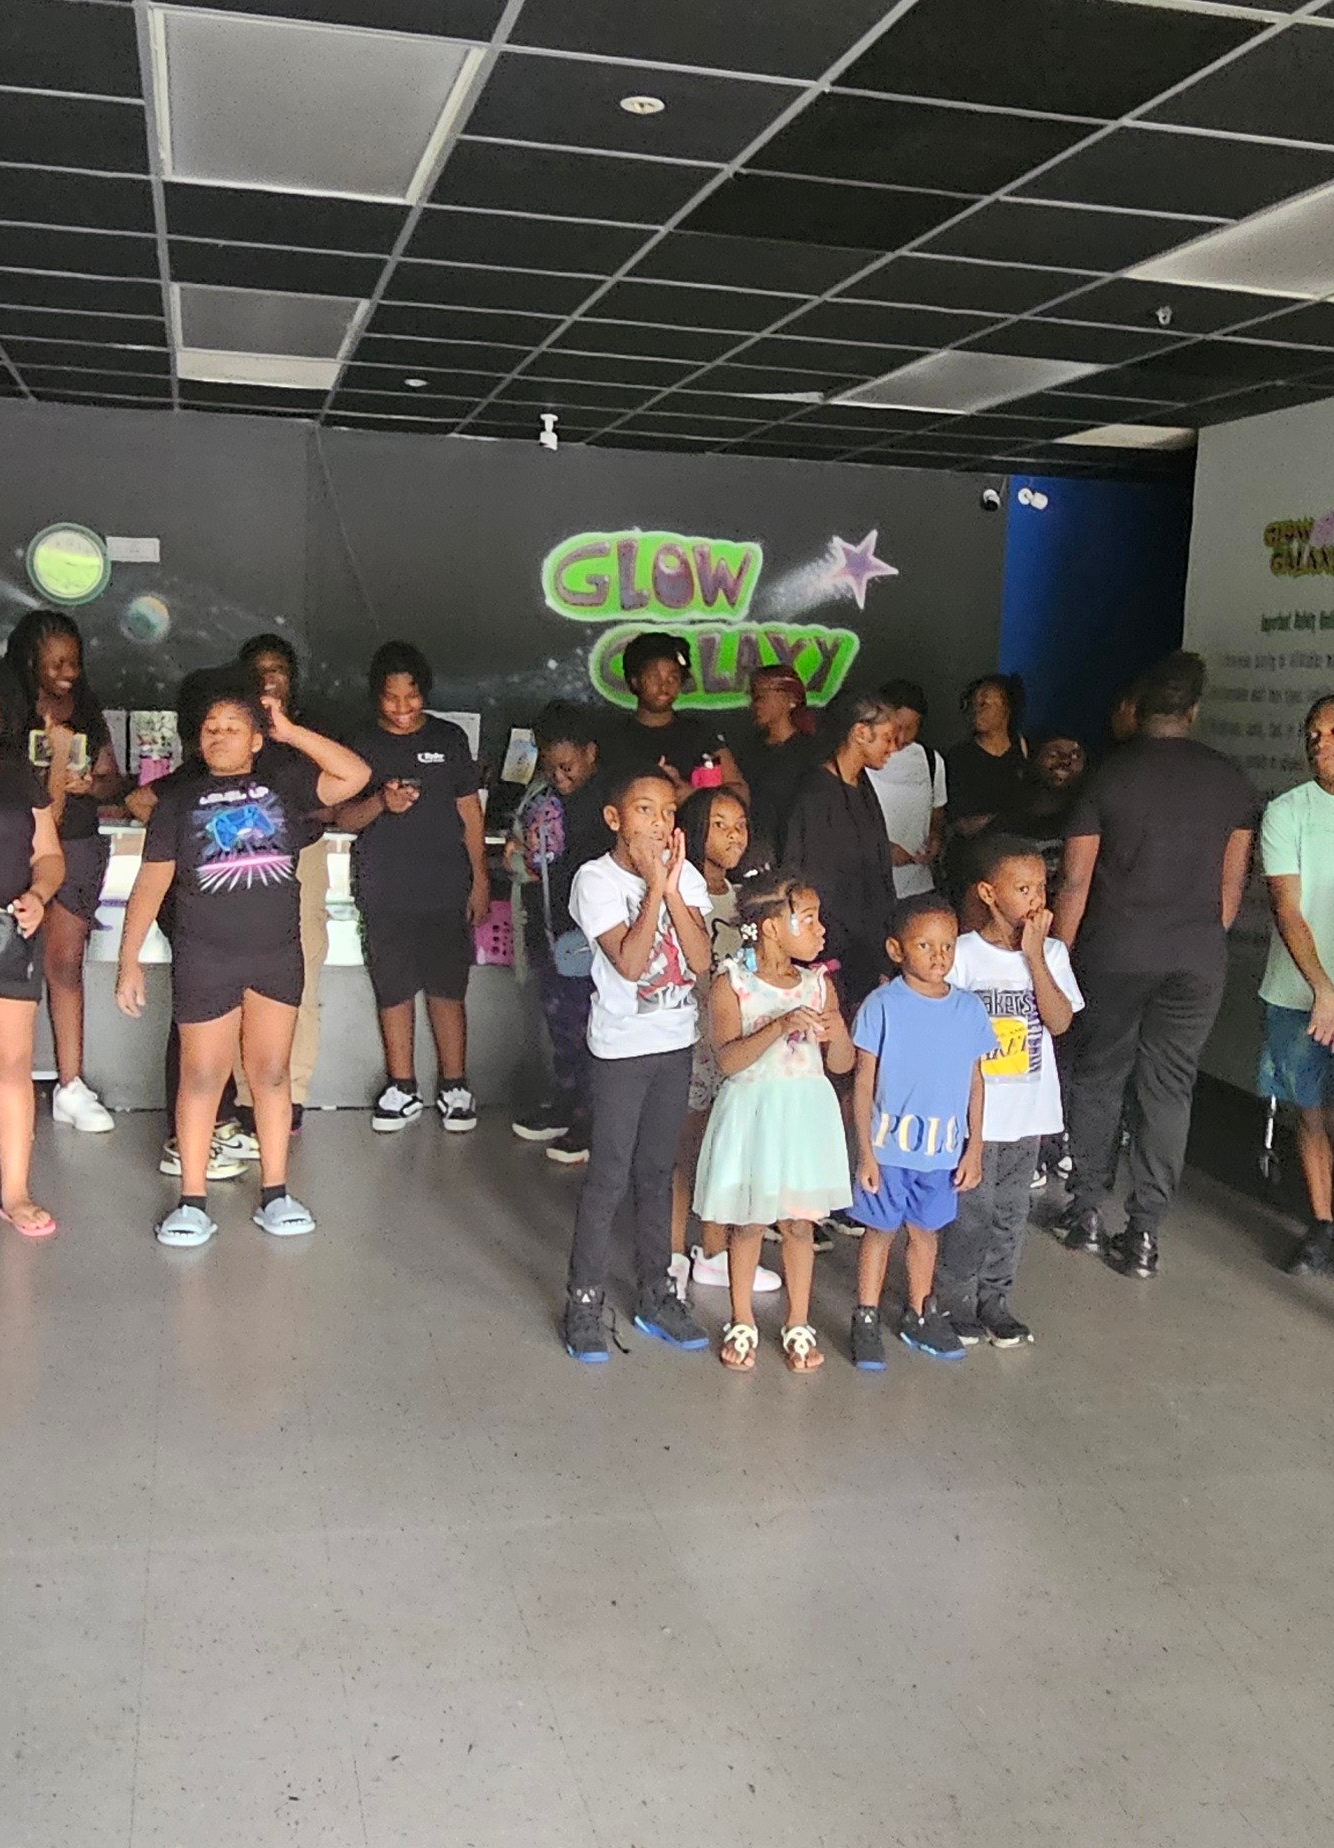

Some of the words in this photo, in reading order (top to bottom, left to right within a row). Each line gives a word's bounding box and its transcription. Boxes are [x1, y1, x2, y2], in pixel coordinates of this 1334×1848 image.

[553, 537, 752, 611] GLOW
[981, 988, 1032, 1015] akers
[873, 1112, 960, 1156] POLO
